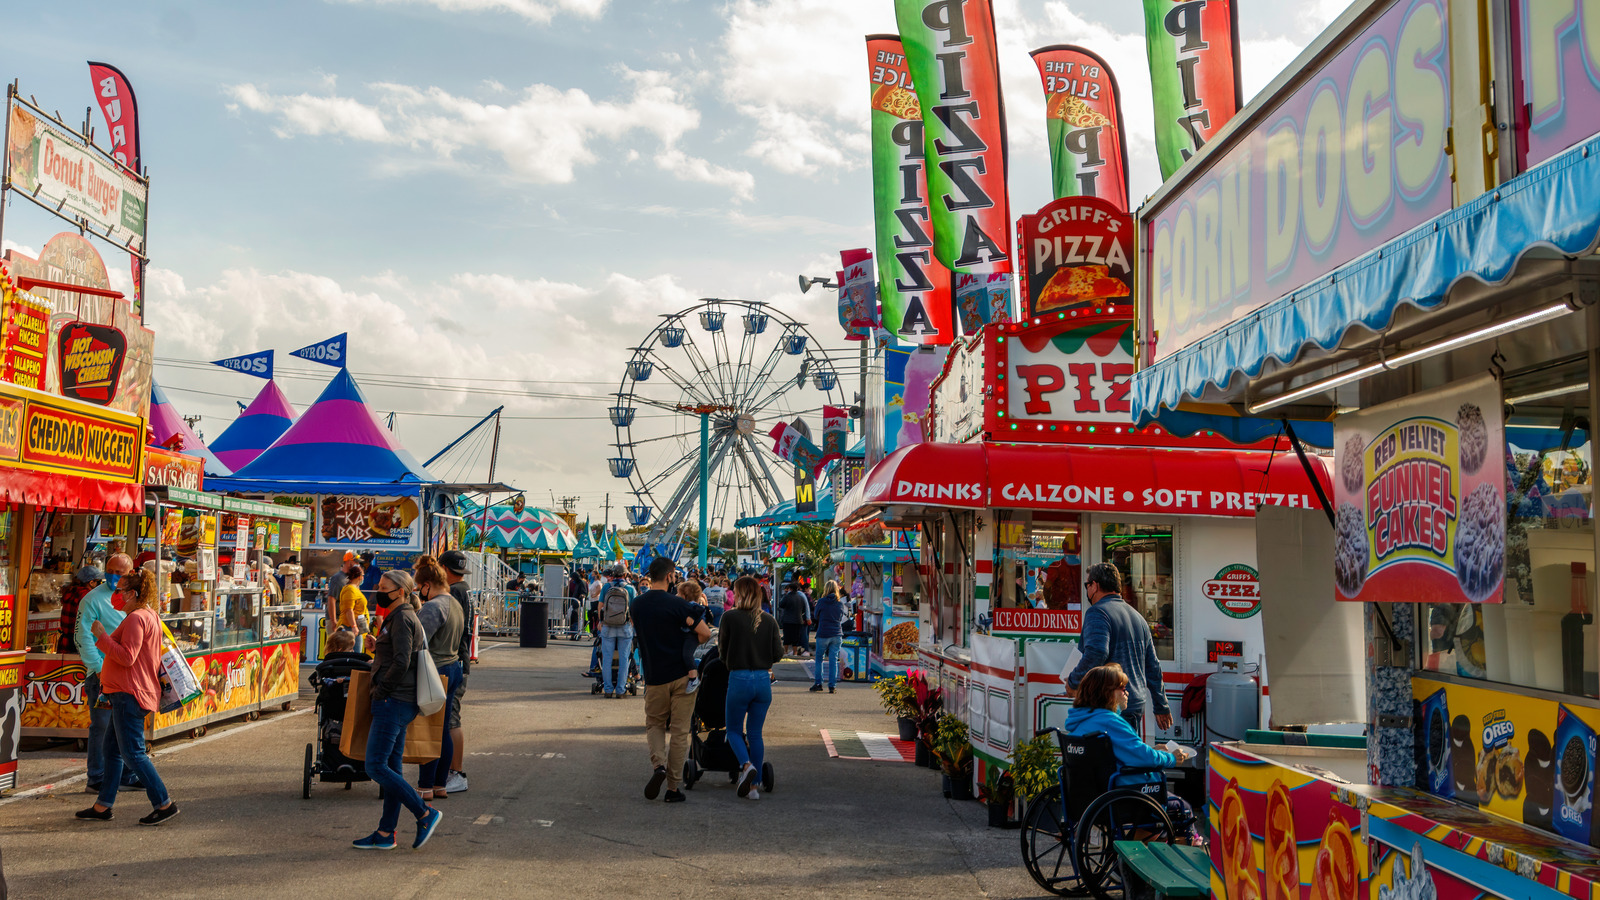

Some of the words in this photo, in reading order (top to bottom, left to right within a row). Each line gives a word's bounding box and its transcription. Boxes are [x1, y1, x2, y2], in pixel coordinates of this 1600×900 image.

[43, 138, 84, 193] Donut
[87, 165, 120, 217] Burger
[1153, 158, 1251, 345] CORN
[1264, 0, 1449, 274] DOGS
[1037, 205, 1123, 234] GRIFF'S
[1033, 235, 1131, 275] PIZZA
[13, 311, 46, 335] MOZZARELLA
[19, 328, 40, 348] FINGERS
[72, 336, 93, 354] HOT
[63, 347, 117, 373] WISCONSIN
[299, 341, 341, 361] GYROS
[13, 355, 41, 376] JALAPENO
[77, 363, 112, 384] CHEESE
[223, 356, 268, 373] GYROS
[13, 371, 39, 390] CHEDDAR
[28, 414, 85, 458] CHEDDAR
[87, 428, 134, 467] NUGGETS
[1373, 433, 1397, 473] RED
[1398, 424, 1447, 458] VELVET
[147, 465, 199, 490] SAUSAGE
[896, 480, 982, 501] DRINKS
[1001, 482, 1116, 505] CALZONE
[1142, 487, 1203, 509] SOFT
[1367, 459, 1457, 528] FUNNEL
[337, 495, 376, 512] SHISH
[336, 525, 373, 541] BOBS
[1375, 503, 1448, 559] CAKES
[995, 611, 1012, 628] ICE
[1013, 612, 1041, 629] COLD
[1042, 613, 1079, 630] DRINKS
[1483, 721, 1514, 745] OREO
[1588, 735, 1597, 752] 10
[1067, 743, 1085, 755] drive
[1141, 784, 1160, 794] drive
[1560, 805, 1583, 825] OREO
